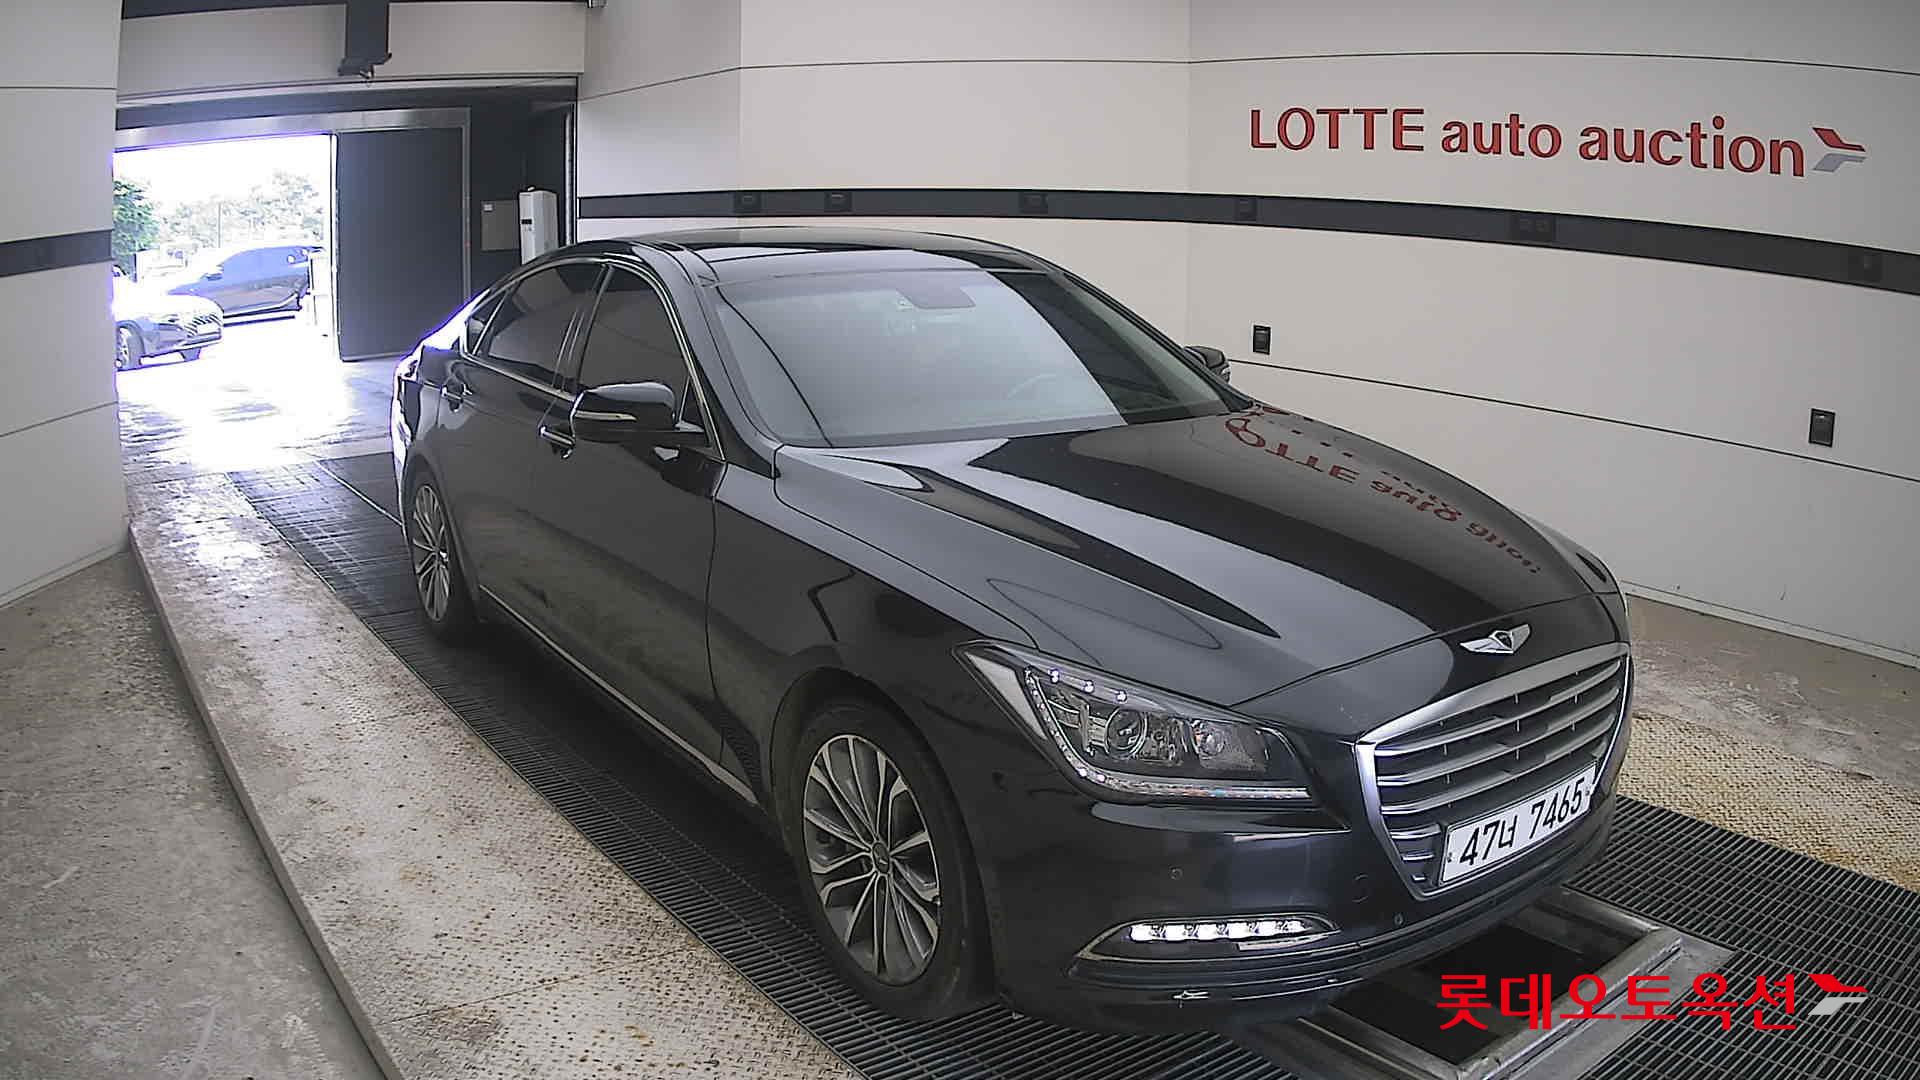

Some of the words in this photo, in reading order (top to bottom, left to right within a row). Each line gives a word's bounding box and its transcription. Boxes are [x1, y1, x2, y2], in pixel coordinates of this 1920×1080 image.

[1250, 107, 1425, 152] LOTTE
[1440, 113, 1562, 159] auto
[1578, 115, 1805, 177] auction
[1459, 814, 1518, 866] 47너
[1528, 776, 1585, 840] 7465
